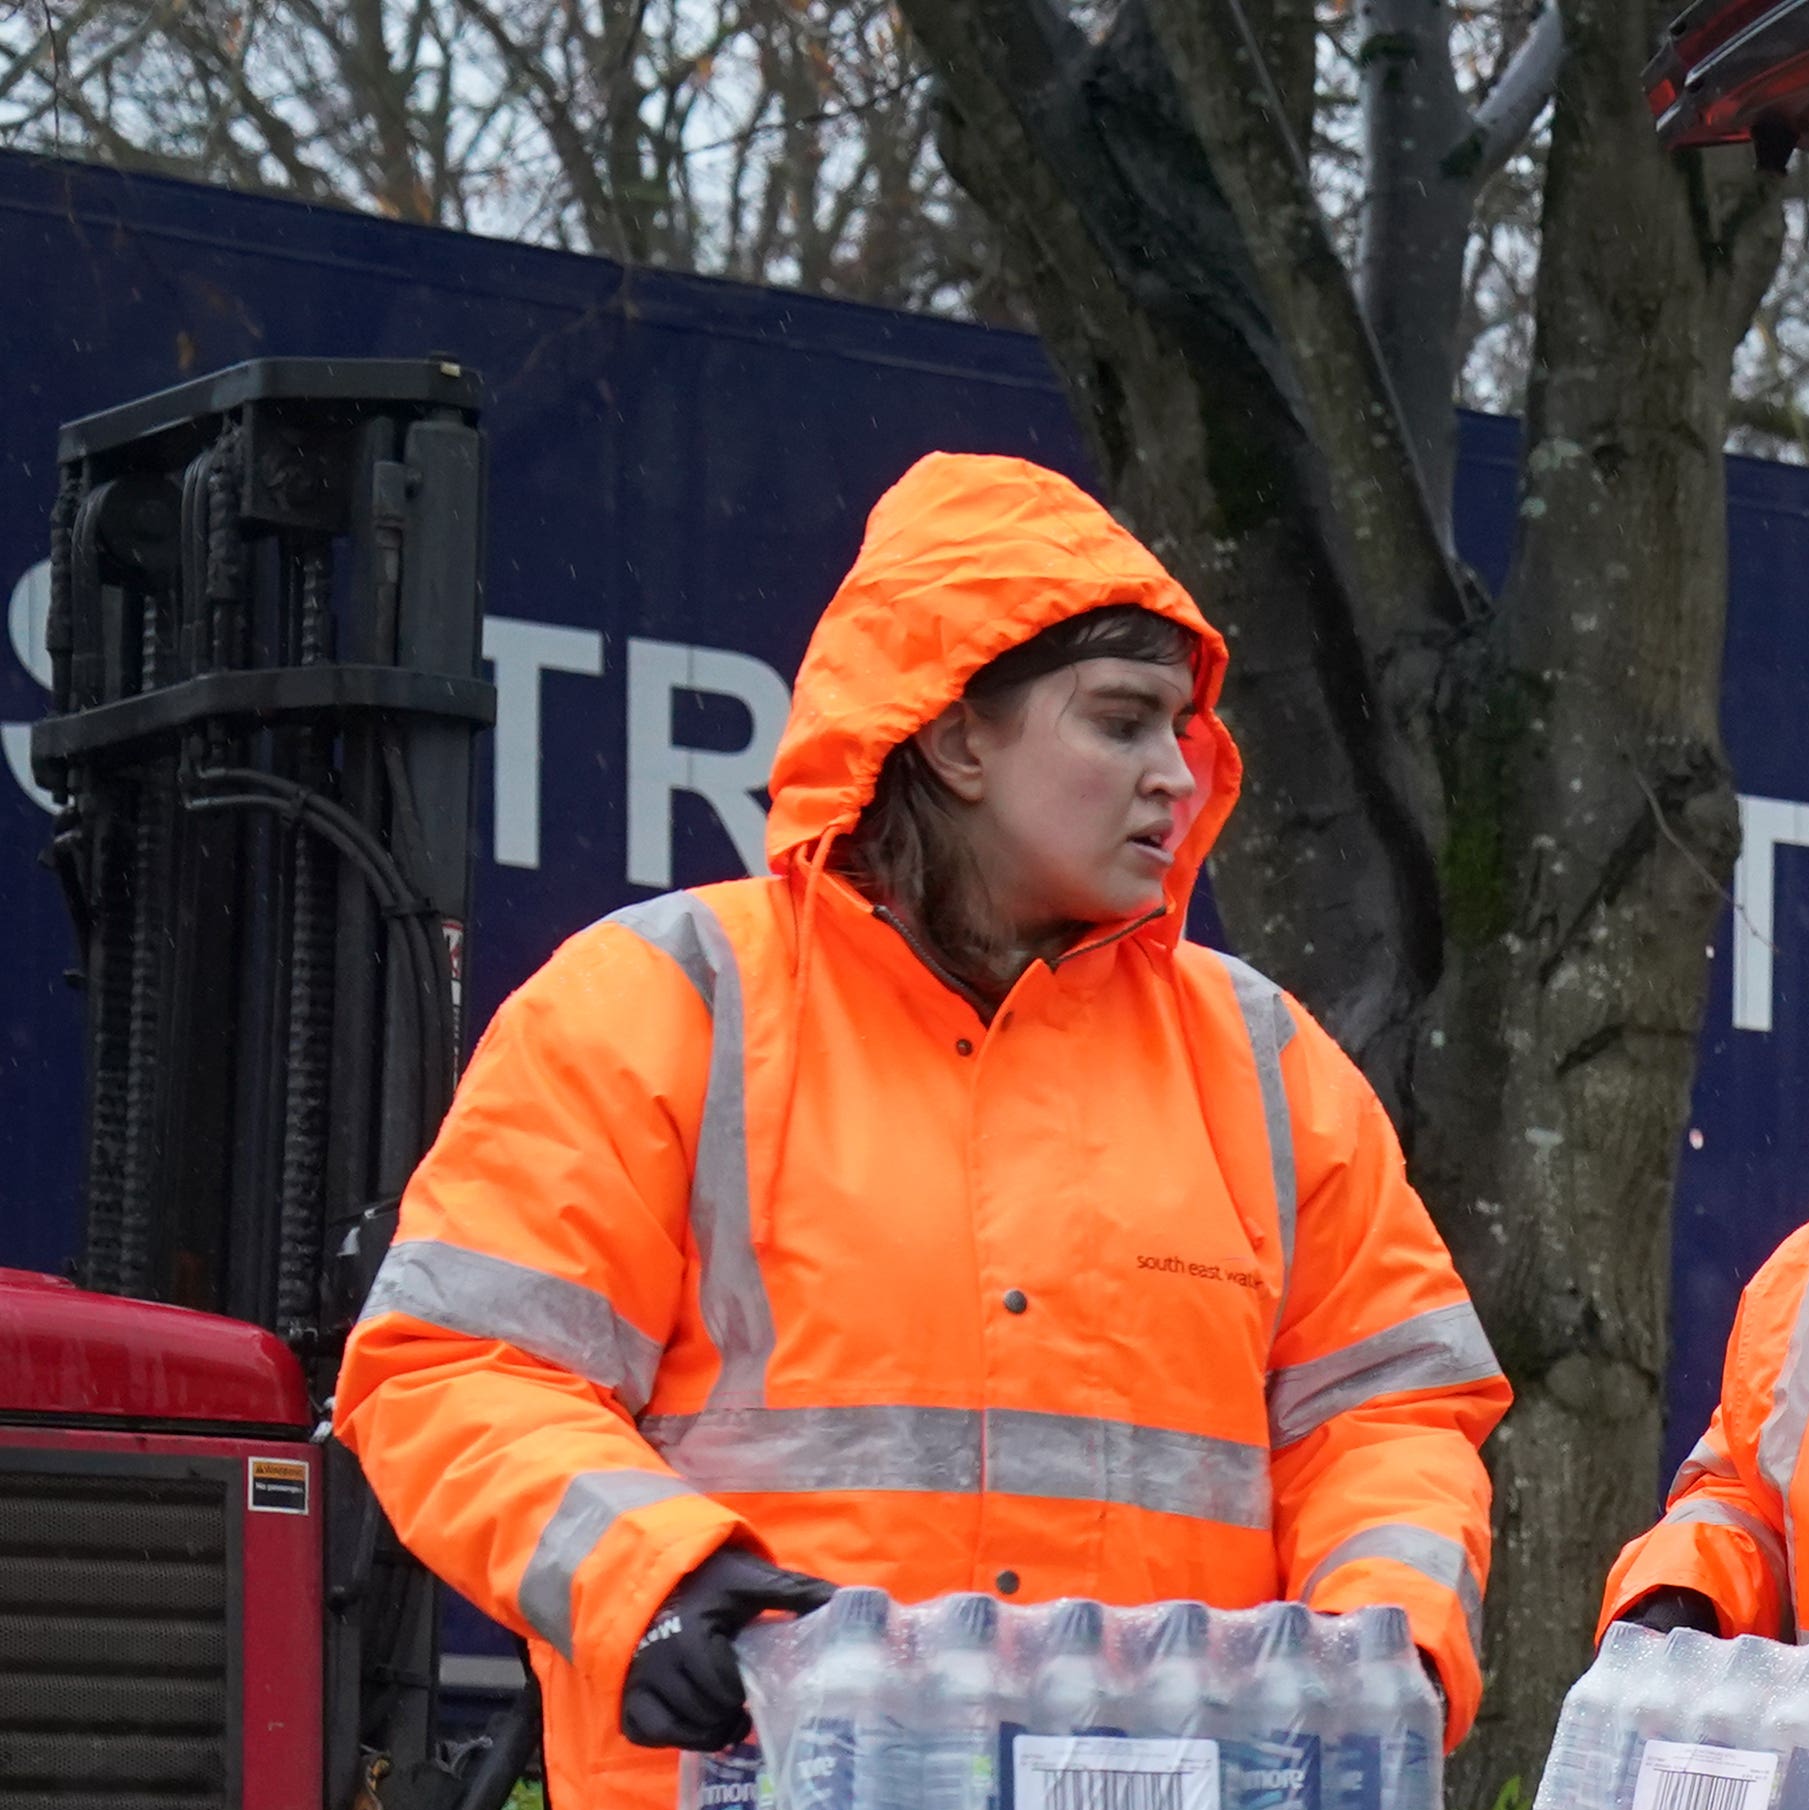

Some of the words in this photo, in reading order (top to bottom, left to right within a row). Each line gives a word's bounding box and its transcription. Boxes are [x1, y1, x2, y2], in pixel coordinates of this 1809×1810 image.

[483, 616, 795, 889] TR
[1136, 1255, 1185, 1273] south
[1188, 1262, 1223, 1281] east
